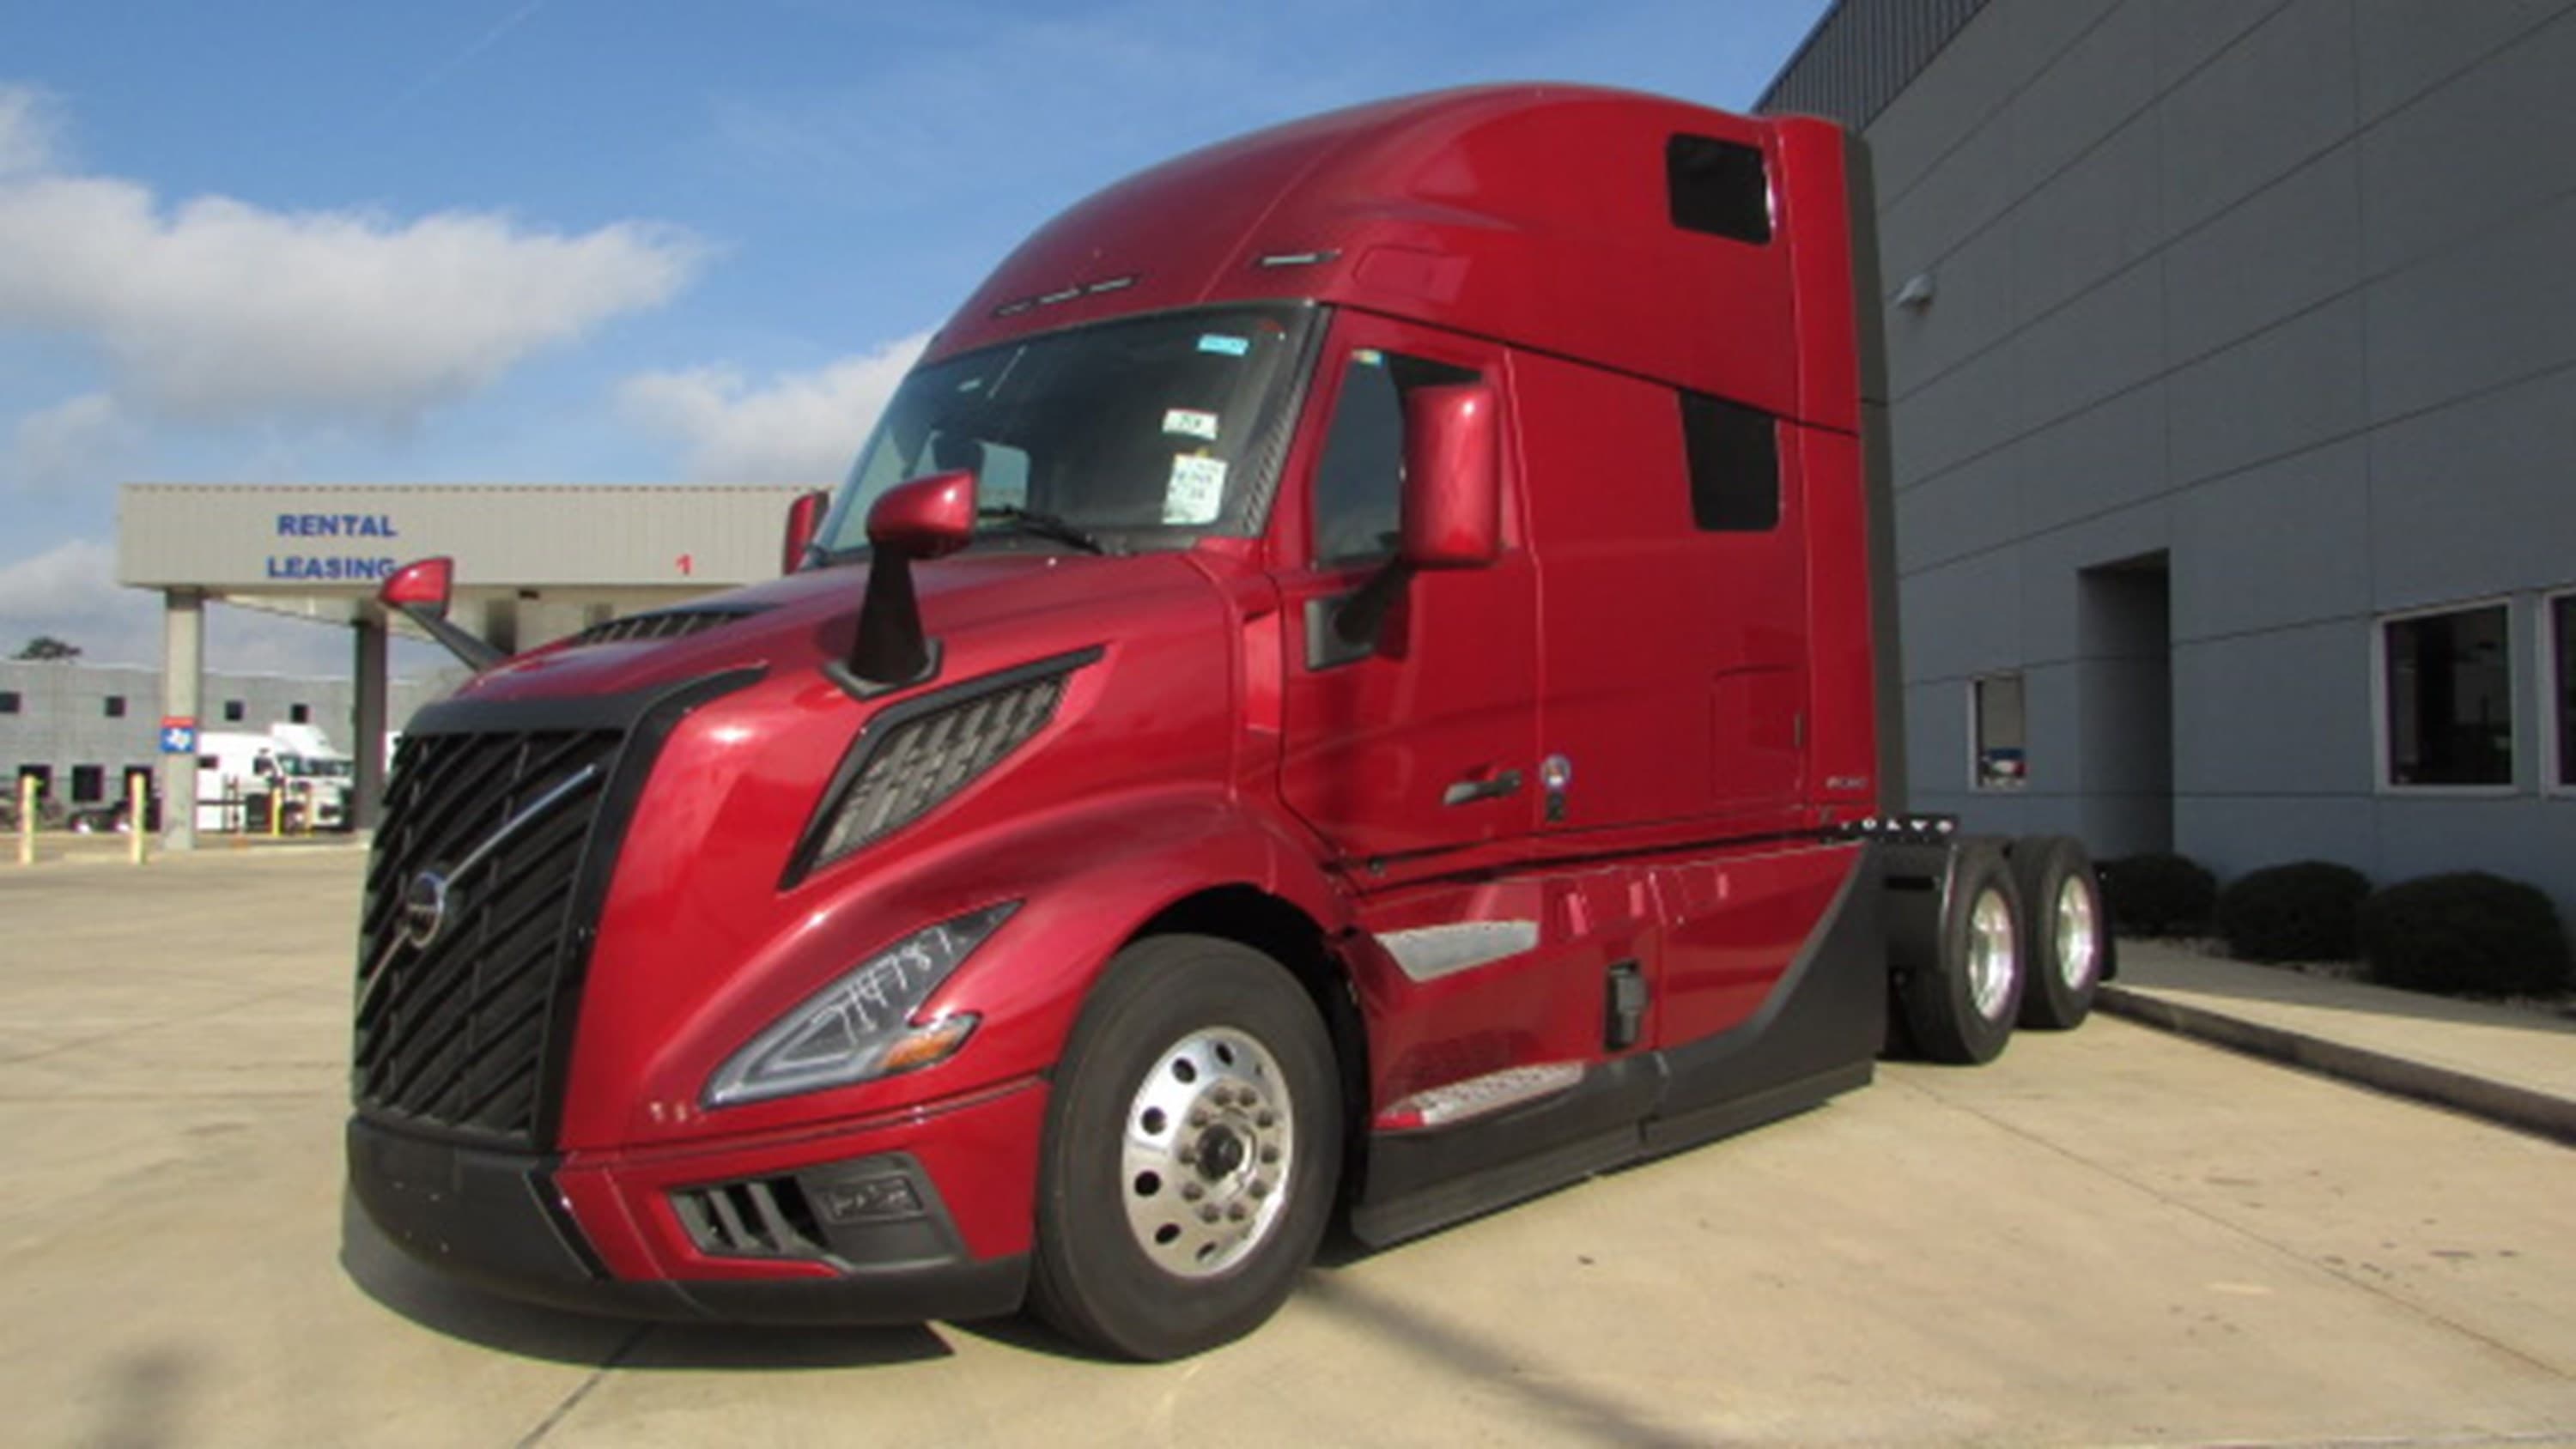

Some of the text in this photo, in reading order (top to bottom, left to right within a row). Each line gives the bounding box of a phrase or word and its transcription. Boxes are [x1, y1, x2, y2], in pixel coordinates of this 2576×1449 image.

[277, 513, 398, 537] RENTAL
[267, 556, 395, 579] LEASING
[676, 554, 691, 575] 1
